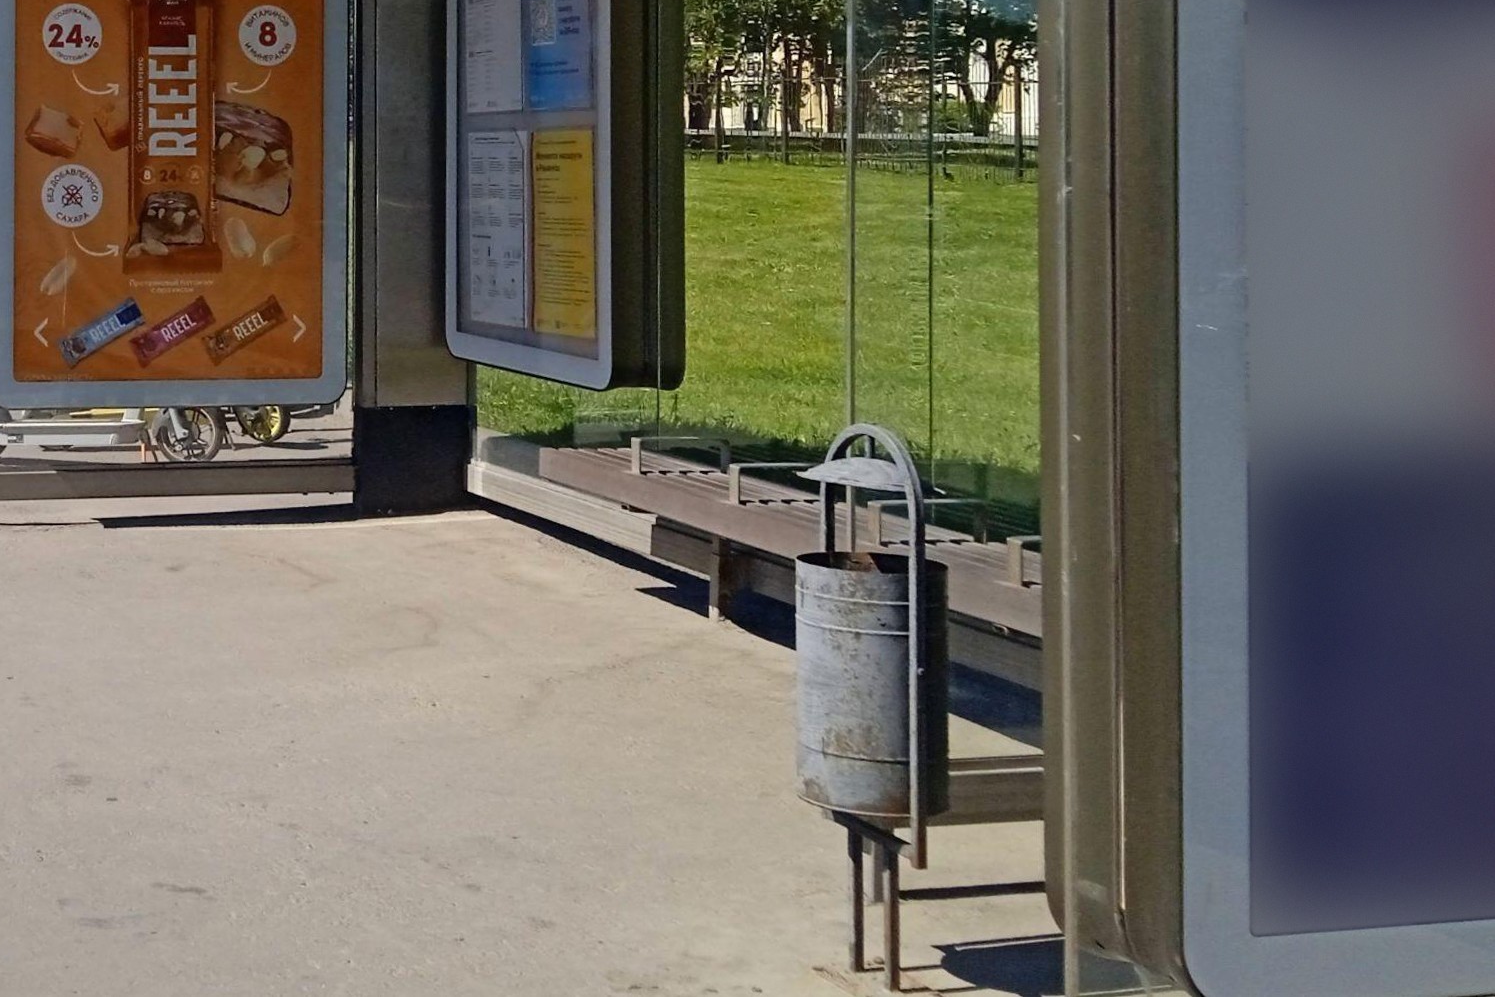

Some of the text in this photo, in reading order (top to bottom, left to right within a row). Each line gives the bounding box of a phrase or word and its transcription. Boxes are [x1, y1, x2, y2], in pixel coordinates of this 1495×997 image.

[48, 23, 100, 49] 24%
[259, 21, 278, 47] 8
[148, 34, 197, 156] REEEL
[56, 211, 89, 223] САХАРА
[160, 313, 197, 343] REEEL
[232, 312, 269, 341] REEEL
